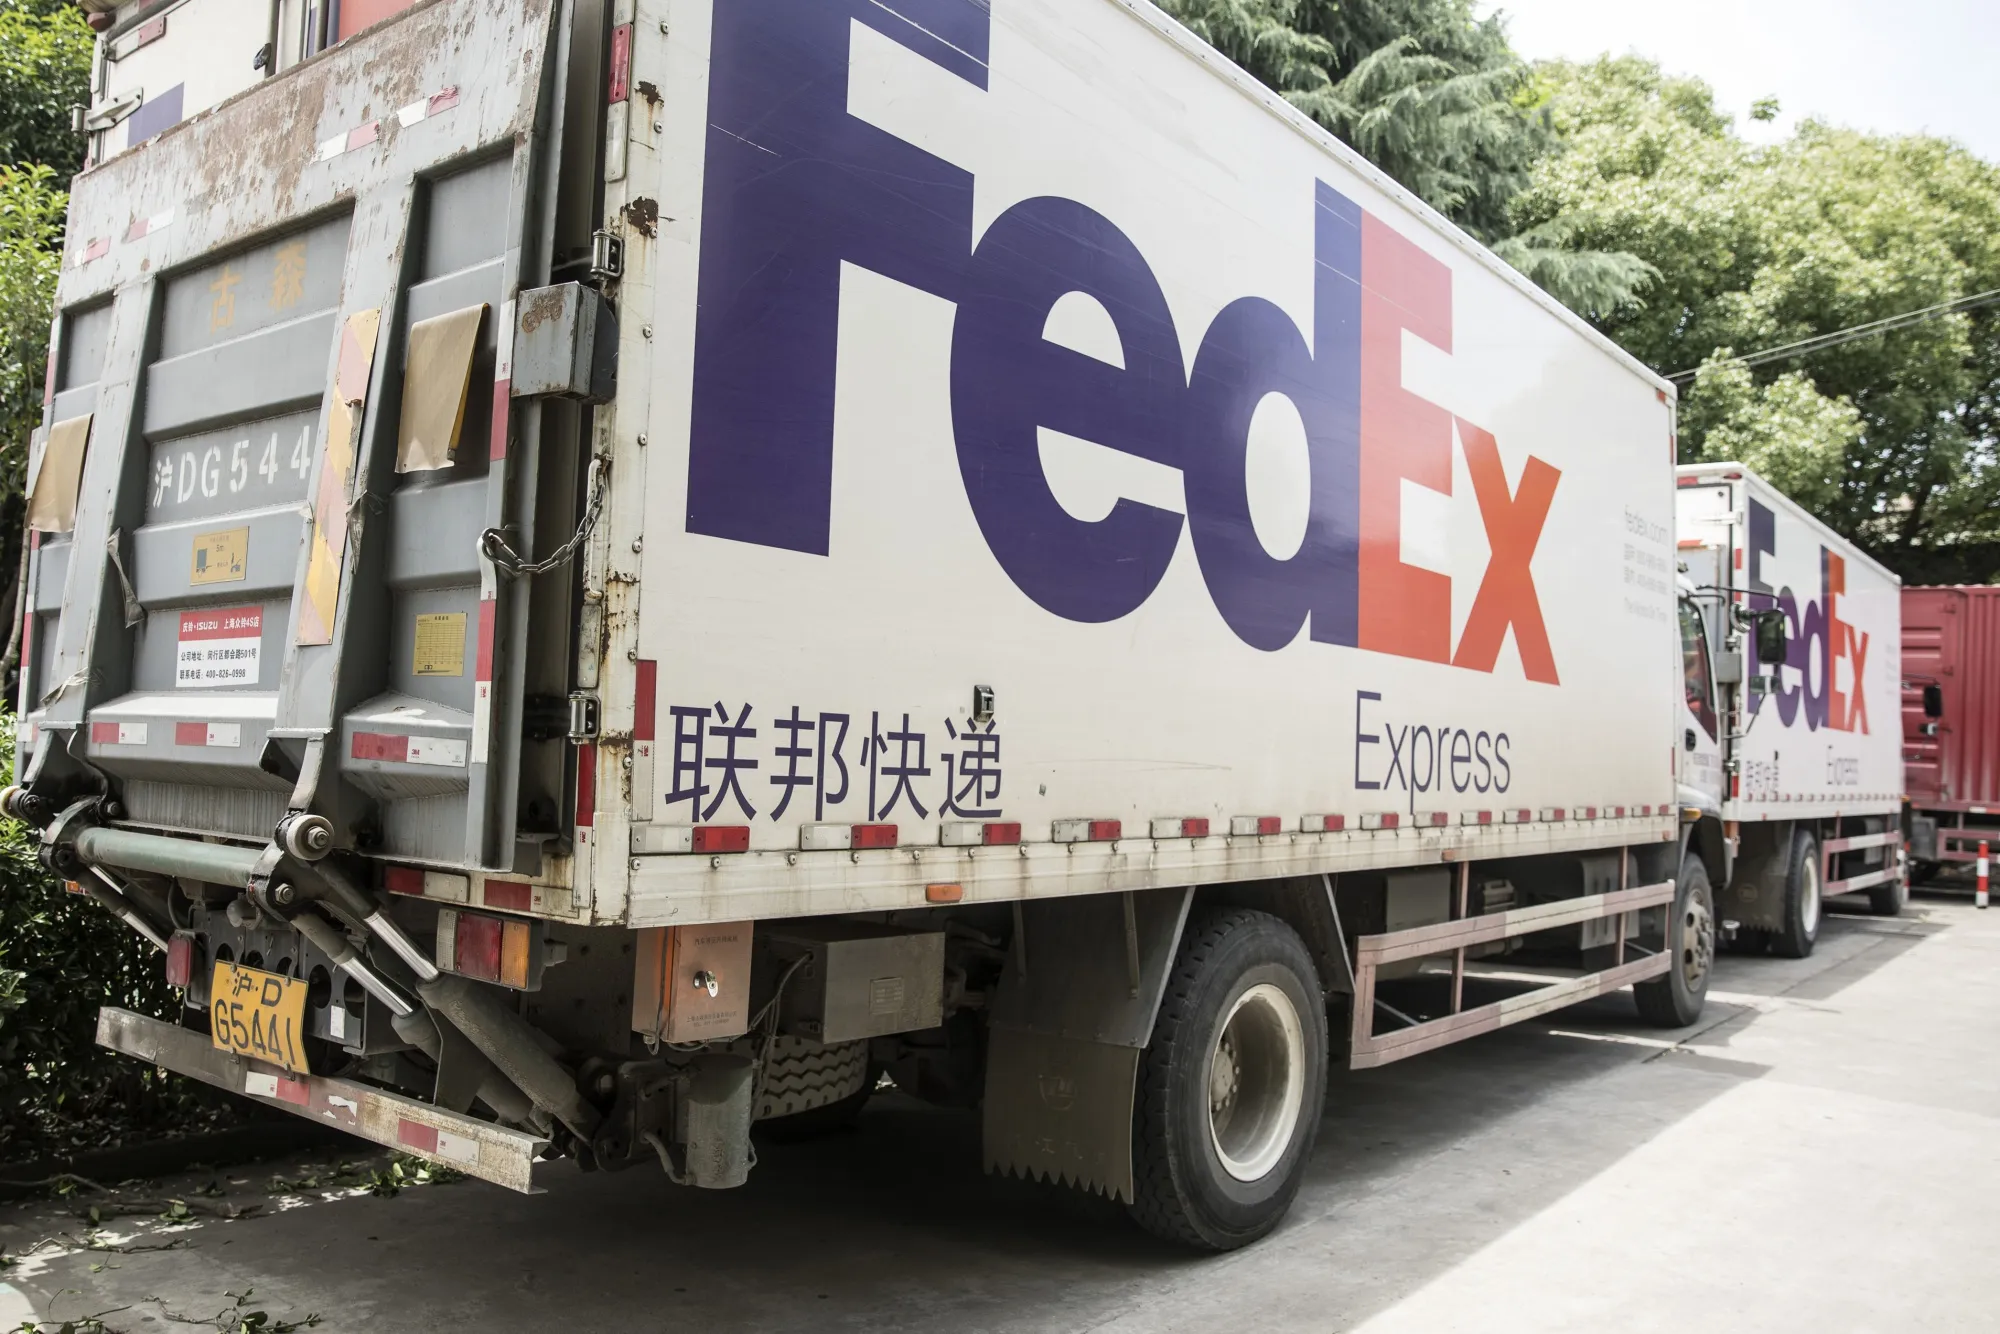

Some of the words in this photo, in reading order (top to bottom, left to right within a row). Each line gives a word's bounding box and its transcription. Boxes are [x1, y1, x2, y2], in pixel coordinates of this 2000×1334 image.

[686, 0, 1561, 685] FedEx
[1747, 496, 1870, 736] FedEx
[664, 700, 1003, 823] 联邦快递
[1355, 689, 1511, 816] Express
